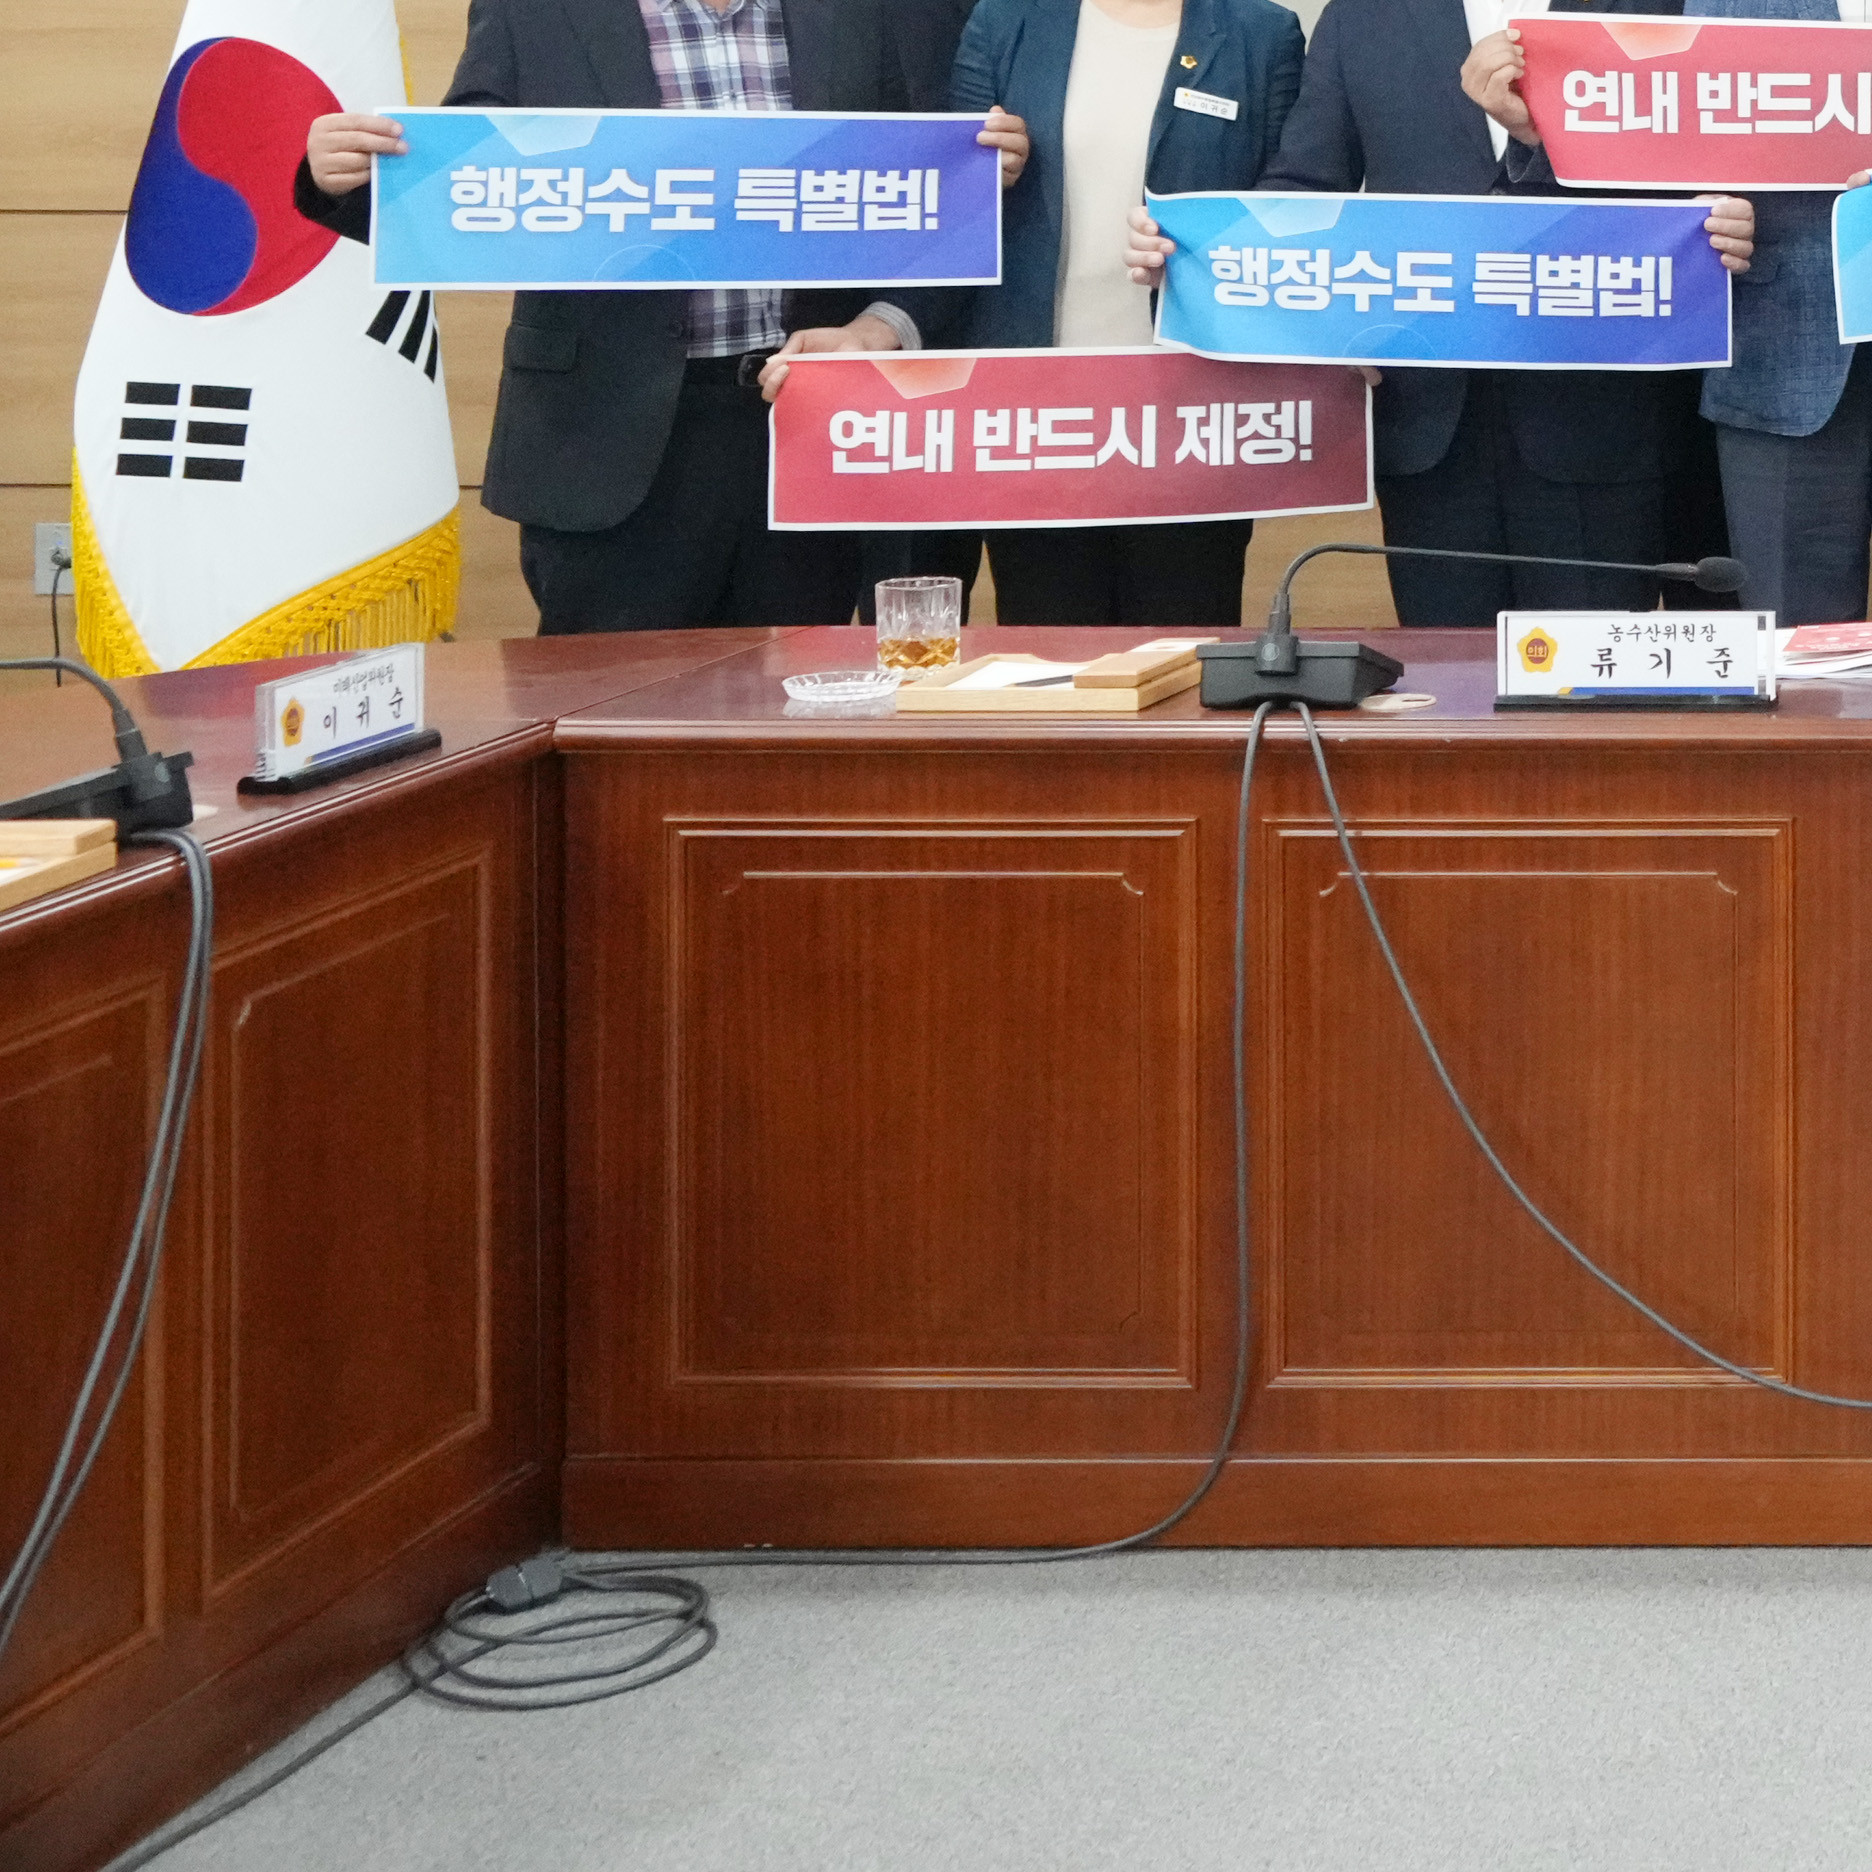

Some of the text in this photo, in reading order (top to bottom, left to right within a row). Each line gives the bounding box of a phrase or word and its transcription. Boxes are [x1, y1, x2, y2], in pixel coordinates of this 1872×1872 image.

[1563, 70, 1678, 133] 연내
[1697, 72, 1871, 134] 반드시
[451, 166, 939, 232] 행정수도 특별법!
[1209, 246, 1672, 316] 행정수도 특별법!
[830, 401, 1311, 473] 연내 반드시 제정!
[1591, 648, 1733, 678] 류기준
[1608, 624, 1716, 642] 농수산위원장
[323, 687, 404, 739] 이귀순
